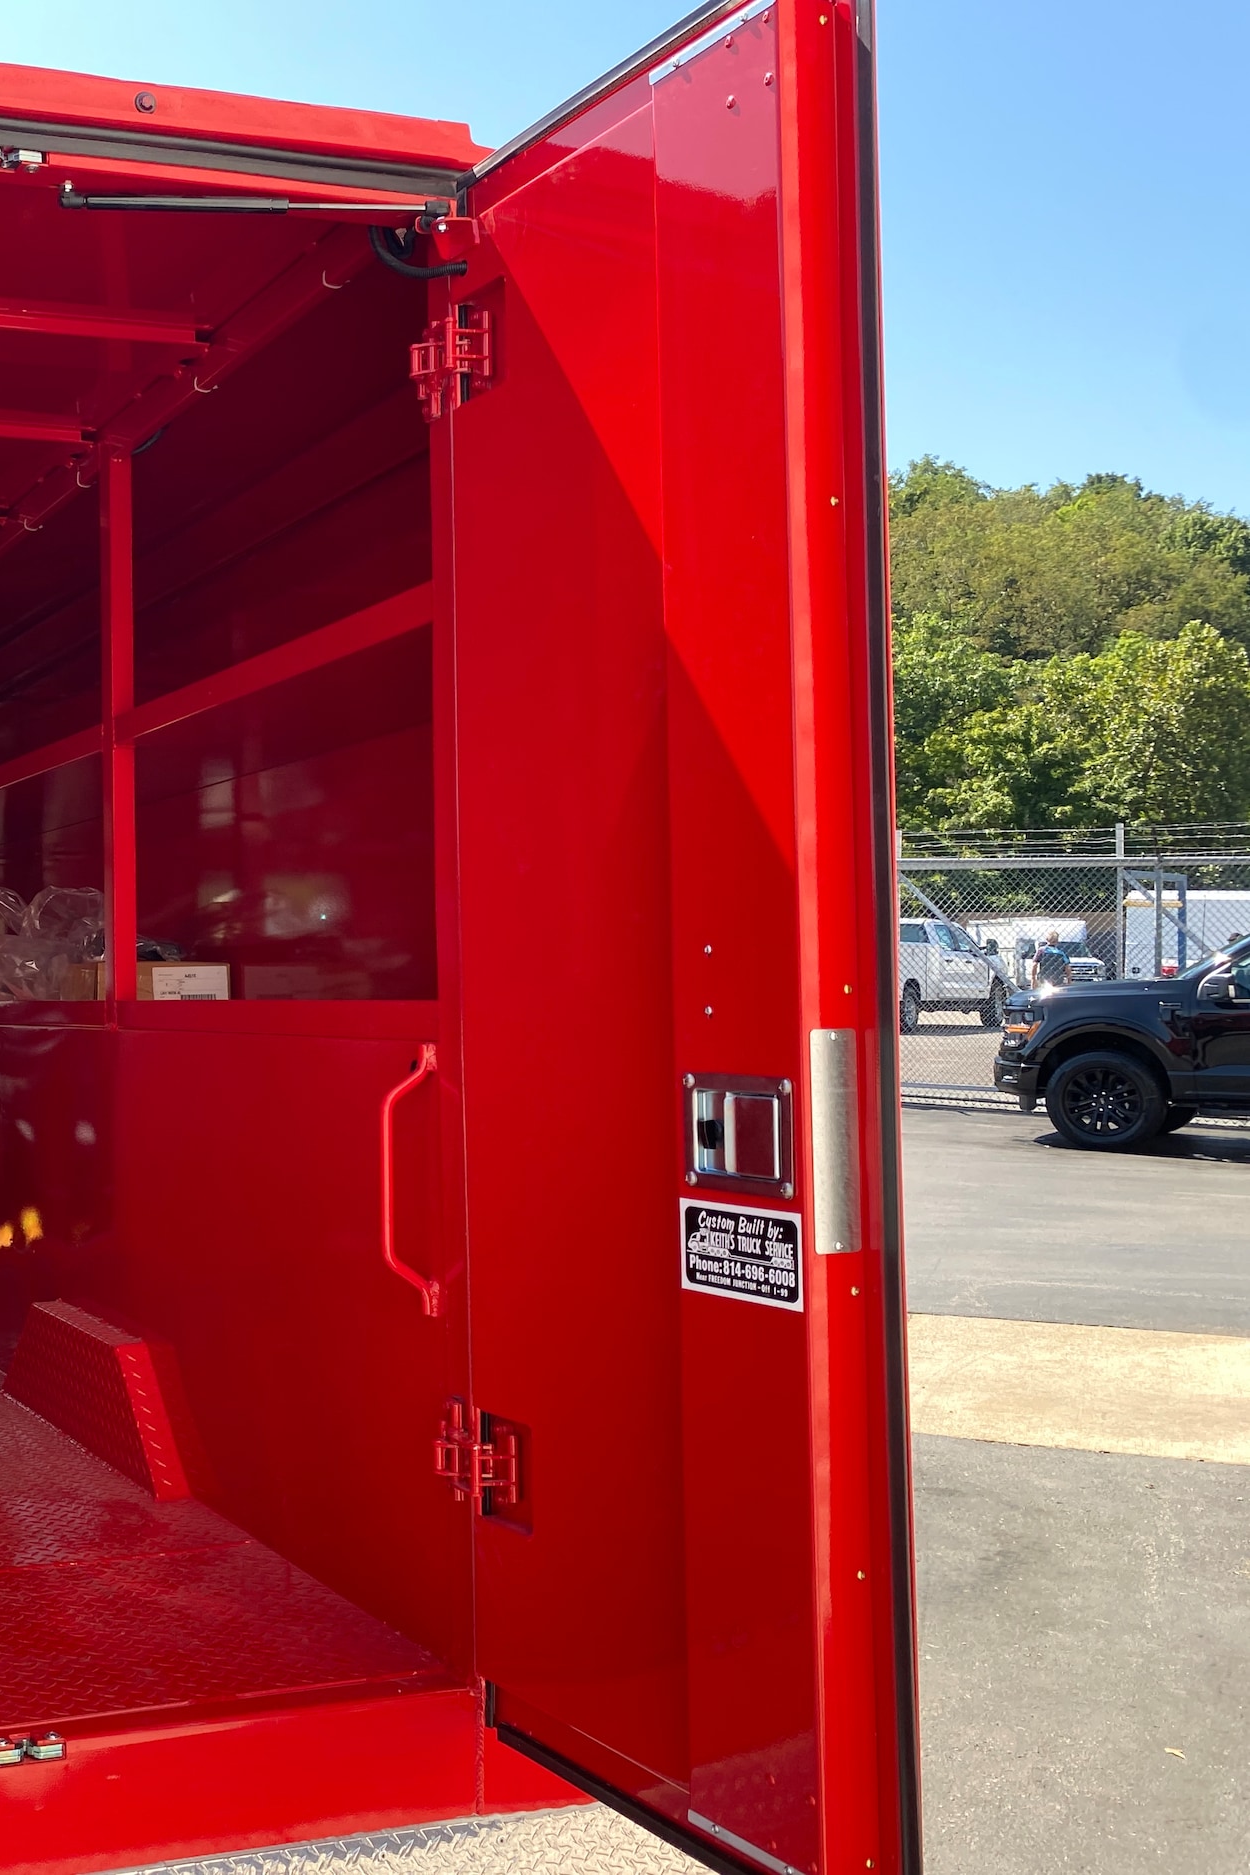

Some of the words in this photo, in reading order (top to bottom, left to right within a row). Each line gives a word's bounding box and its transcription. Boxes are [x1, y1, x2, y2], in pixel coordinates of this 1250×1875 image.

[698, 1210, 735, 1234] Custom
[738, 1216, 765, 1235] Built
[767, 1221, 784, 1241] by:
[737, 1235, 762, 1255] TRUCK
[765, 1240, 794, 1260] SERVICE
[708, 1274, 731, 1286] FREEDOM
[732, 1279, 757, 1291] JUNCTION
[761, 1284, 771, 1294] Off
